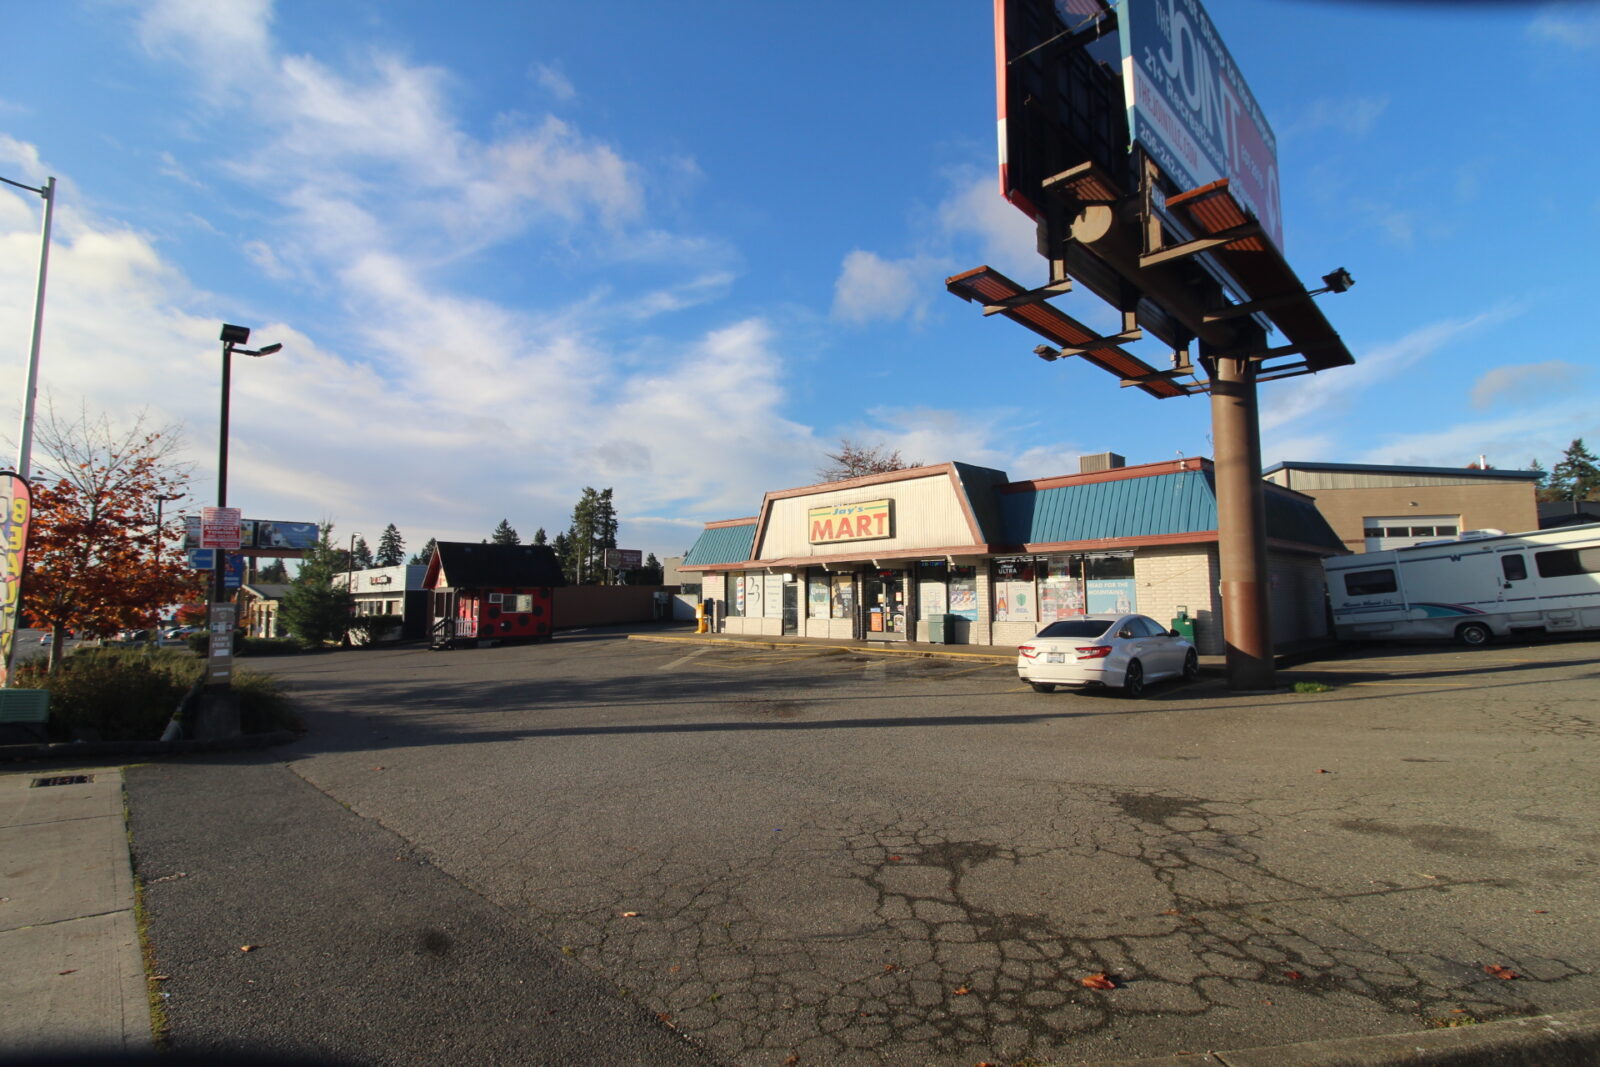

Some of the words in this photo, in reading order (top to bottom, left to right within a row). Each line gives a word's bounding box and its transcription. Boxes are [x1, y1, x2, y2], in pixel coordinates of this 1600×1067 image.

[1155, 0, 1171, 43] THE
[1200, 12, 1225, 68] Shop
[1226, 58, 1237, 86] to
[1144, 46, 1164, 83] 21+
[1165, 74, 1225, 173] Recreational
[1159, 0, 1241, 173] JOINT
[811, 512, 887, 541] MART
[832, 506, 864, 515] Jay's
